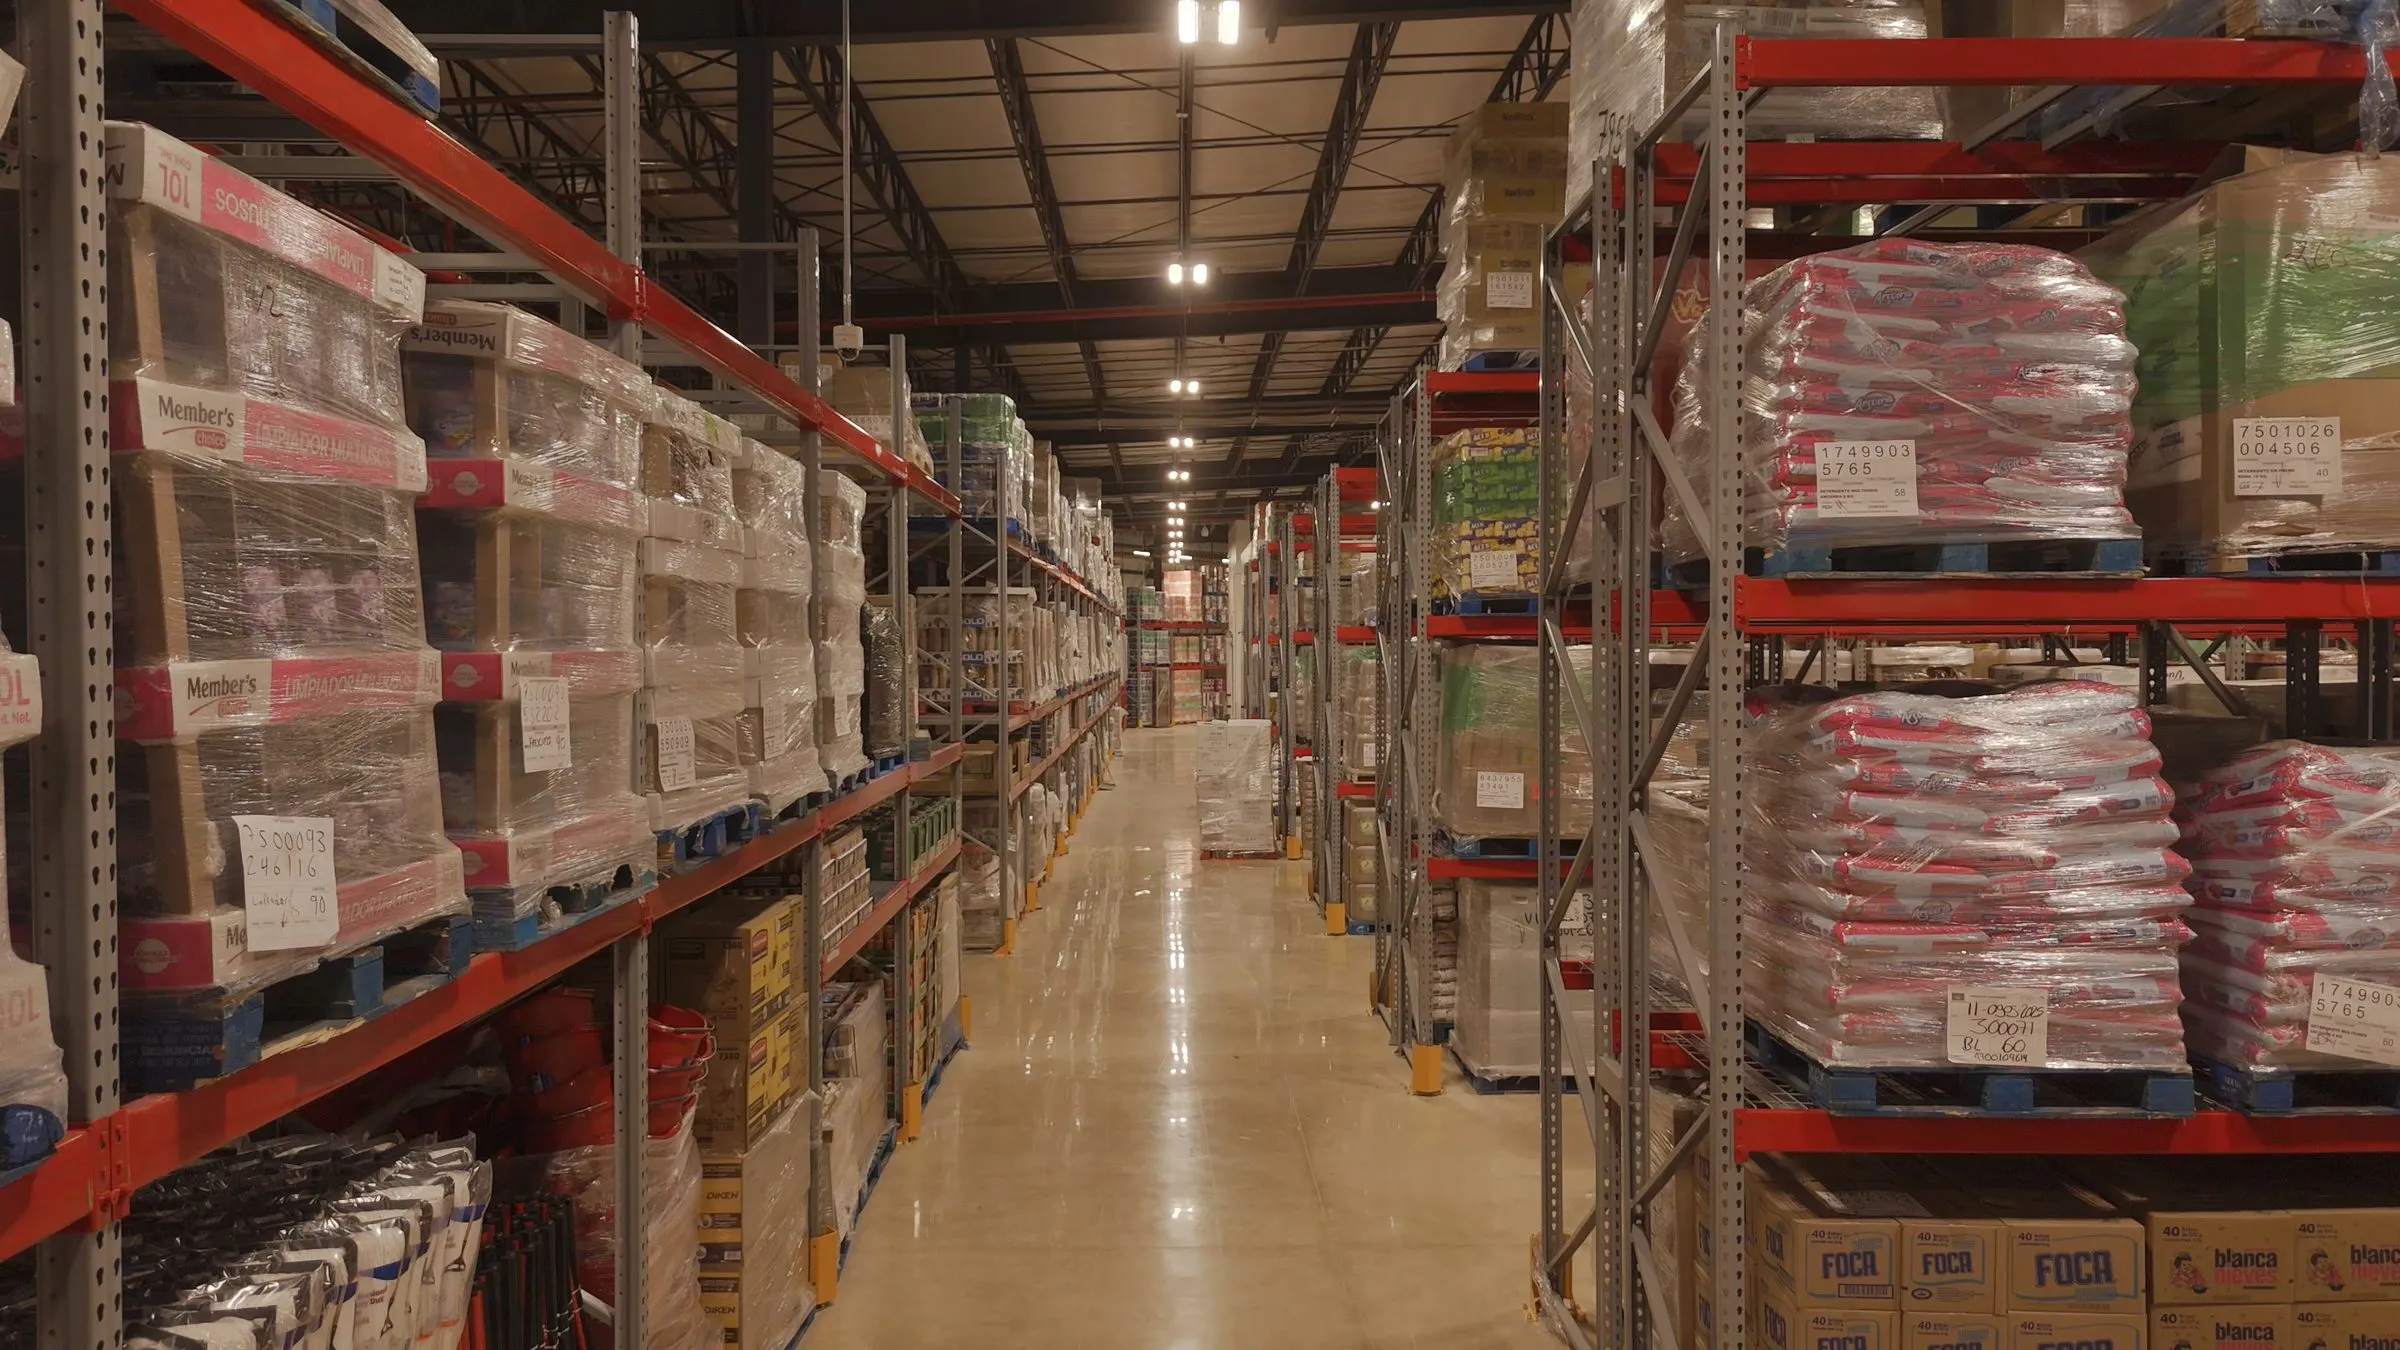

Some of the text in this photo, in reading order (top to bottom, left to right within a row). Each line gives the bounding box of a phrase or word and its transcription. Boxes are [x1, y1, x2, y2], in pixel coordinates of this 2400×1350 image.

[158, 162, 191, 210] 10L
[411, 326, 496, 351] Member's
[158, 395, 234, 428] Member's
[195, 430, 227, 449] choice
[2240, 424, 2334, 438] 7501026
[1822, 444, 1910, 458] 1749903
[2240, 442, 2320, 455] 004506
[1822, 462, 1872, 475] 5765
[2316, 468, 2329, 477] 40
[0, 667, 31, 706] 0L
[187, 674, 257, 700] Member's
[242, 824, 326, 853] 7500093
[246, 854, 317, 878] 246116
[310, 894, 326, 917] 90
[2317, 998, 2365, 1019] 5765
[2001, 1036, 2027, 1053] 60
[2382, 1038, 2394, 1047] 60
[1811, 1230, 1826, 1239] 40
[1916, 1231, 1932, 1241] 40
[2018, 1232, 2033, 1241] 40
[2163, 1226, 2180, 1237] 40
[2298, 1223, 2316, 1234] 40
[2214, 1248, 2278, 1268] blanca
[2350, 1244, 2400, 1265] blanc
[1822, 1251, 1880, 1279] FOCA
[1922, 1251, 1974, 1276] FOCA
[2035, 1250, 2116, 1288] FOCA
[2214, 1268, 2277, 1285] nieves
[2350, 1264, 2400, 1281] nieve
[1811, 1316, 1827, 1326] 40
[2160, 1313, 2177, 1324] 40
[2297, 1312, 2314, 1322] 40
[1917, 1321, 1932, 1331] 40
[2020, 1321, 2036, 1331] 40
[2215, 1322, 2275, 1341] blanca
[2349, 1333, 2400, 1350] blanc
